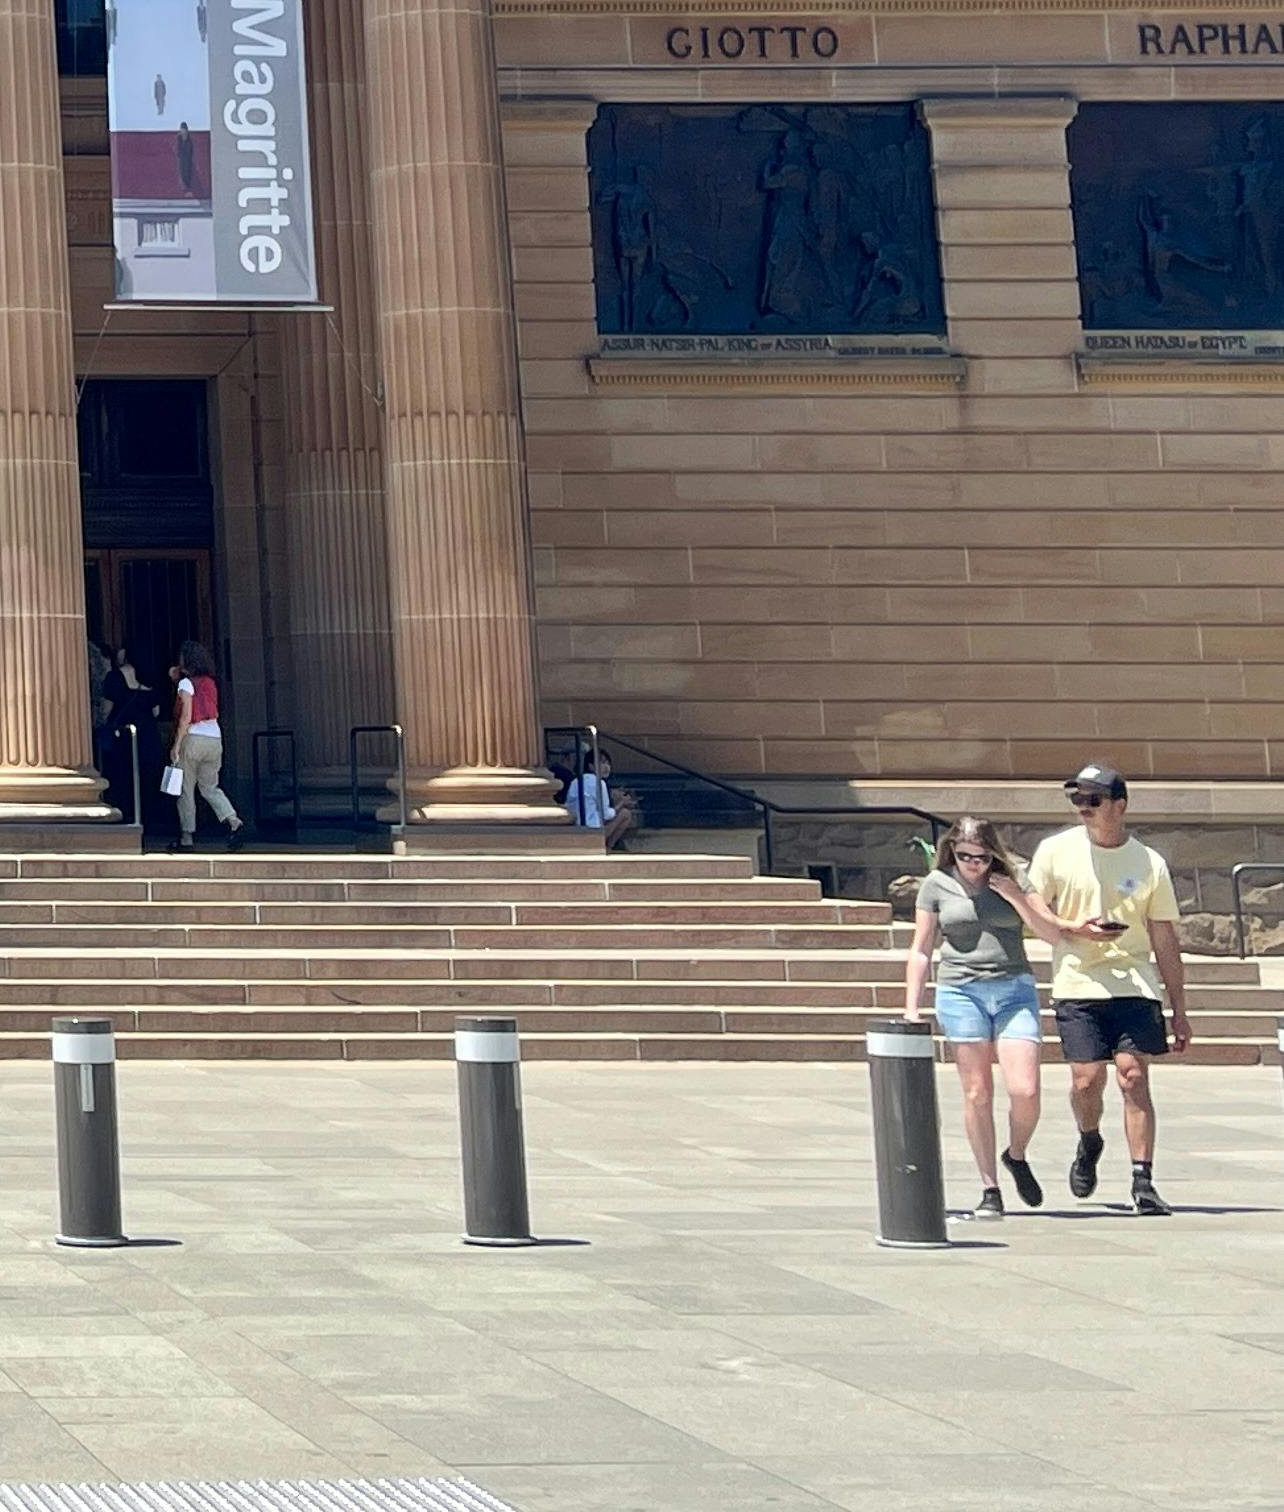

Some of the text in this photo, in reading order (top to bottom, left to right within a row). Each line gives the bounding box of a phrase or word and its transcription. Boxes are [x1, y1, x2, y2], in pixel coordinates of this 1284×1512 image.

[664, 24, 840, 60] GIOTTO
[1137, 23, 1284, 55] RAPHA
[1085, 335, 1132, 350] QUEEN
